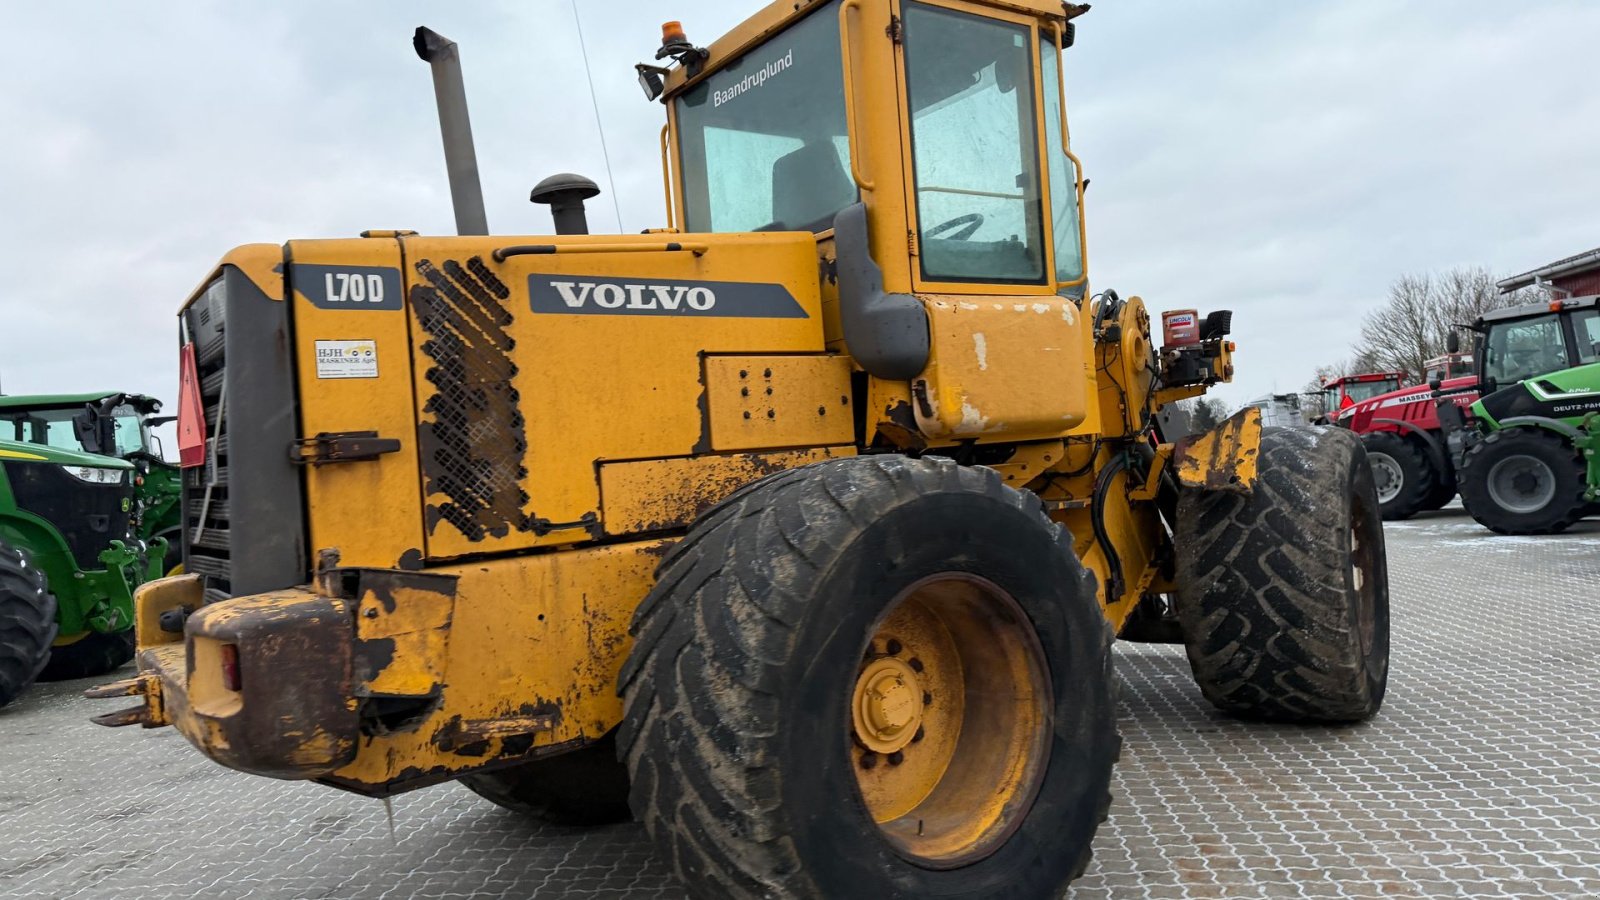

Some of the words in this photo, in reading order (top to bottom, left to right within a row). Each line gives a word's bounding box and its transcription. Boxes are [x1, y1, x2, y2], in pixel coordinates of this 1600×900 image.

[713, 48, 793, 108] Baandruplund
[550, 281, 716, 311] VOLVO
[1169, 316, 1192, 324] LINCOLN
[318, 348, 343, 357] HJH
[1399, 393, 1431, 403] MASSEY
